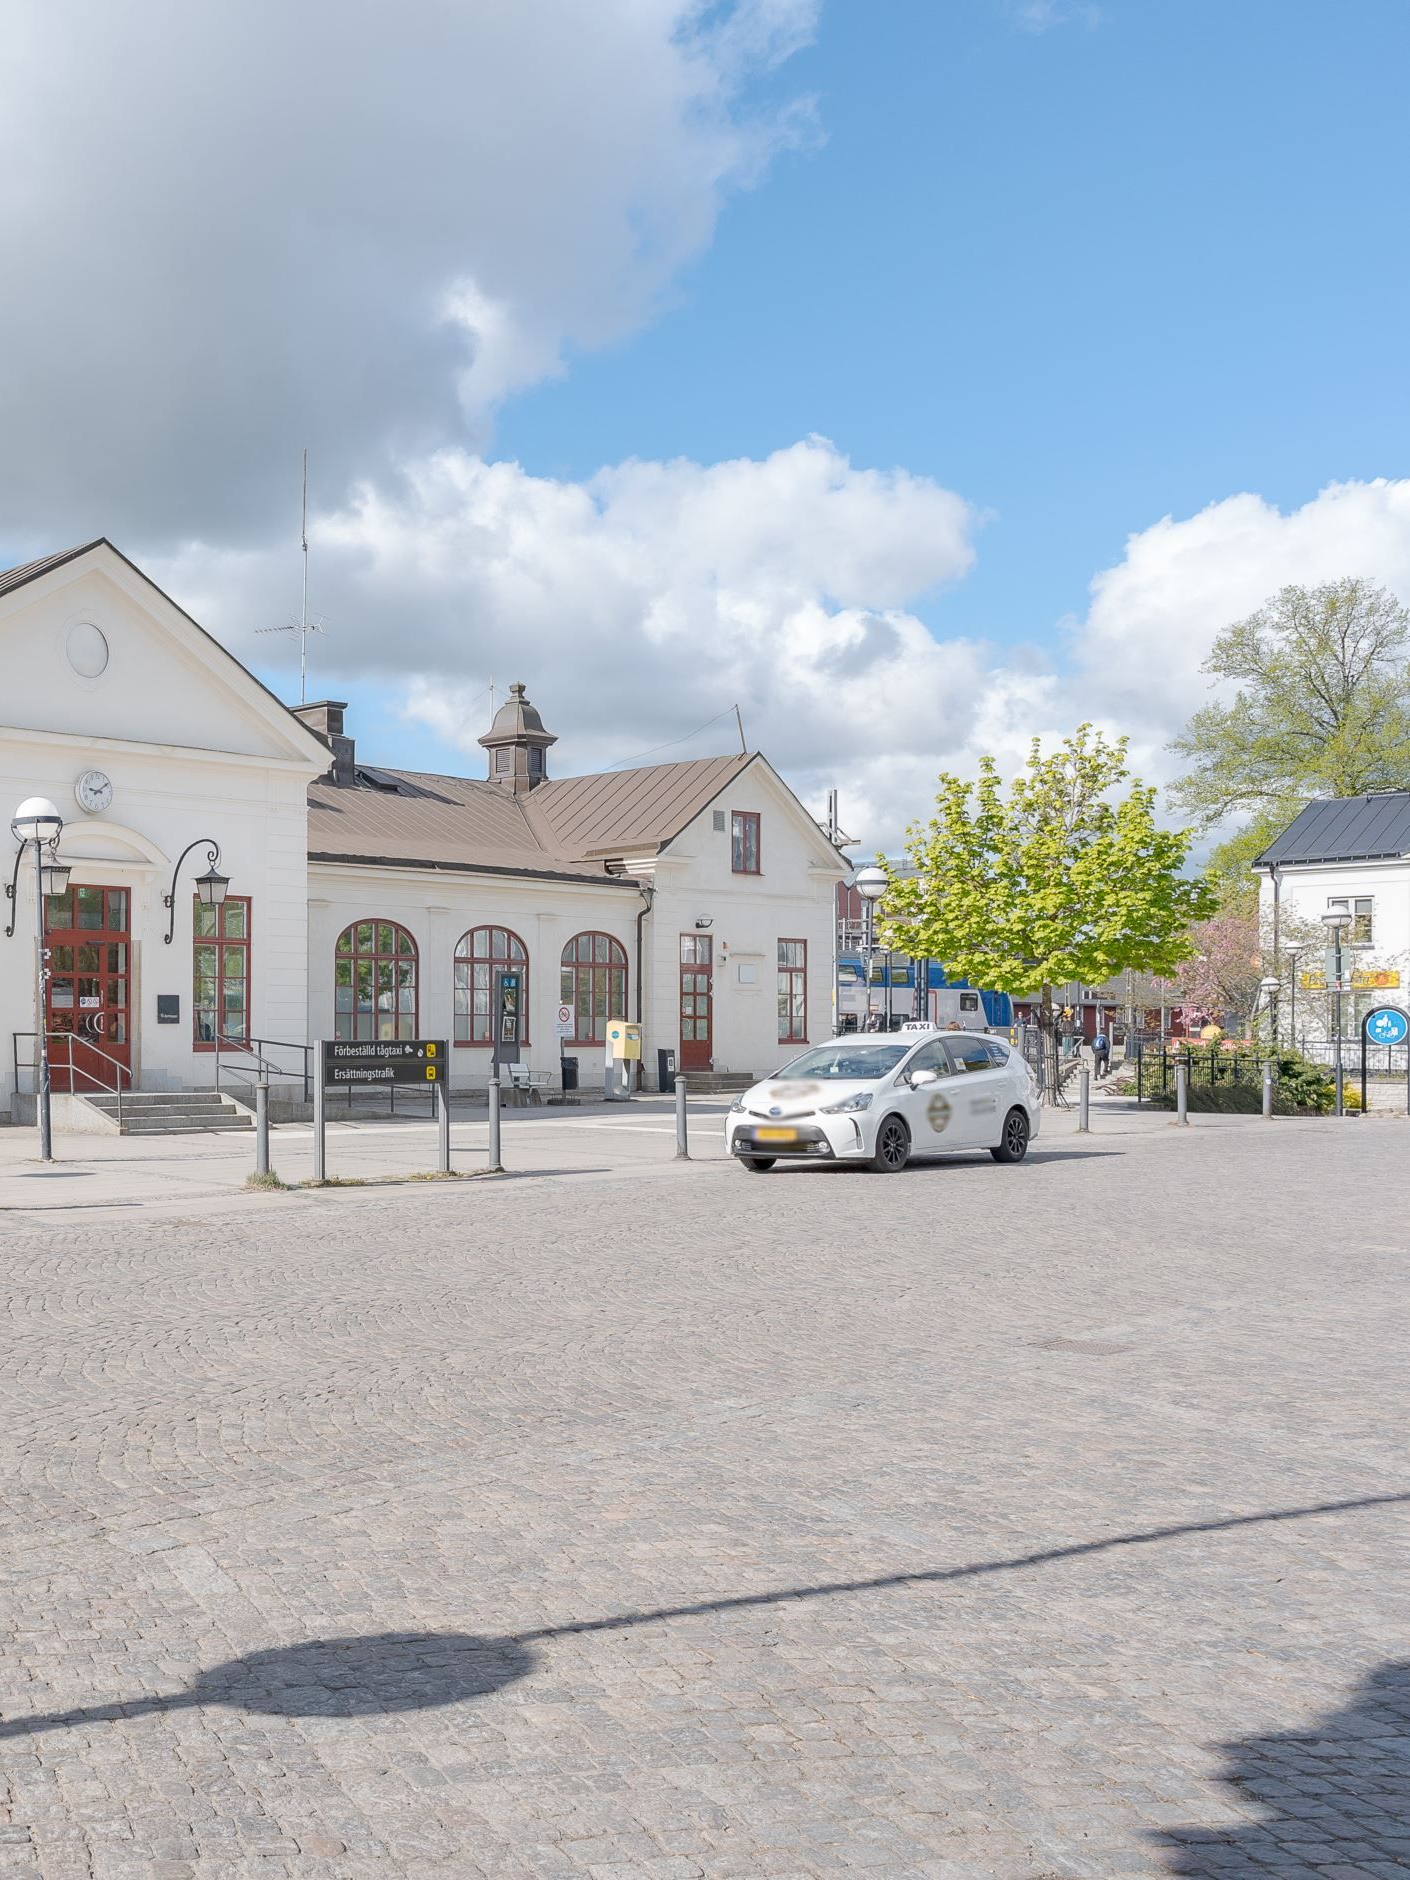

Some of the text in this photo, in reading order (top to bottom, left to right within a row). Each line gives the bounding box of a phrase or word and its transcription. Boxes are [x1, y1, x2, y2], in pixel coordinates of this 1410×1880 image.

[905, 1023, 930, 1031] TAXI
[334, 1043, 403, 1058] Förbeställd tågtaxi
[334, 1067, 395, 1081] Ersättningstrafik
